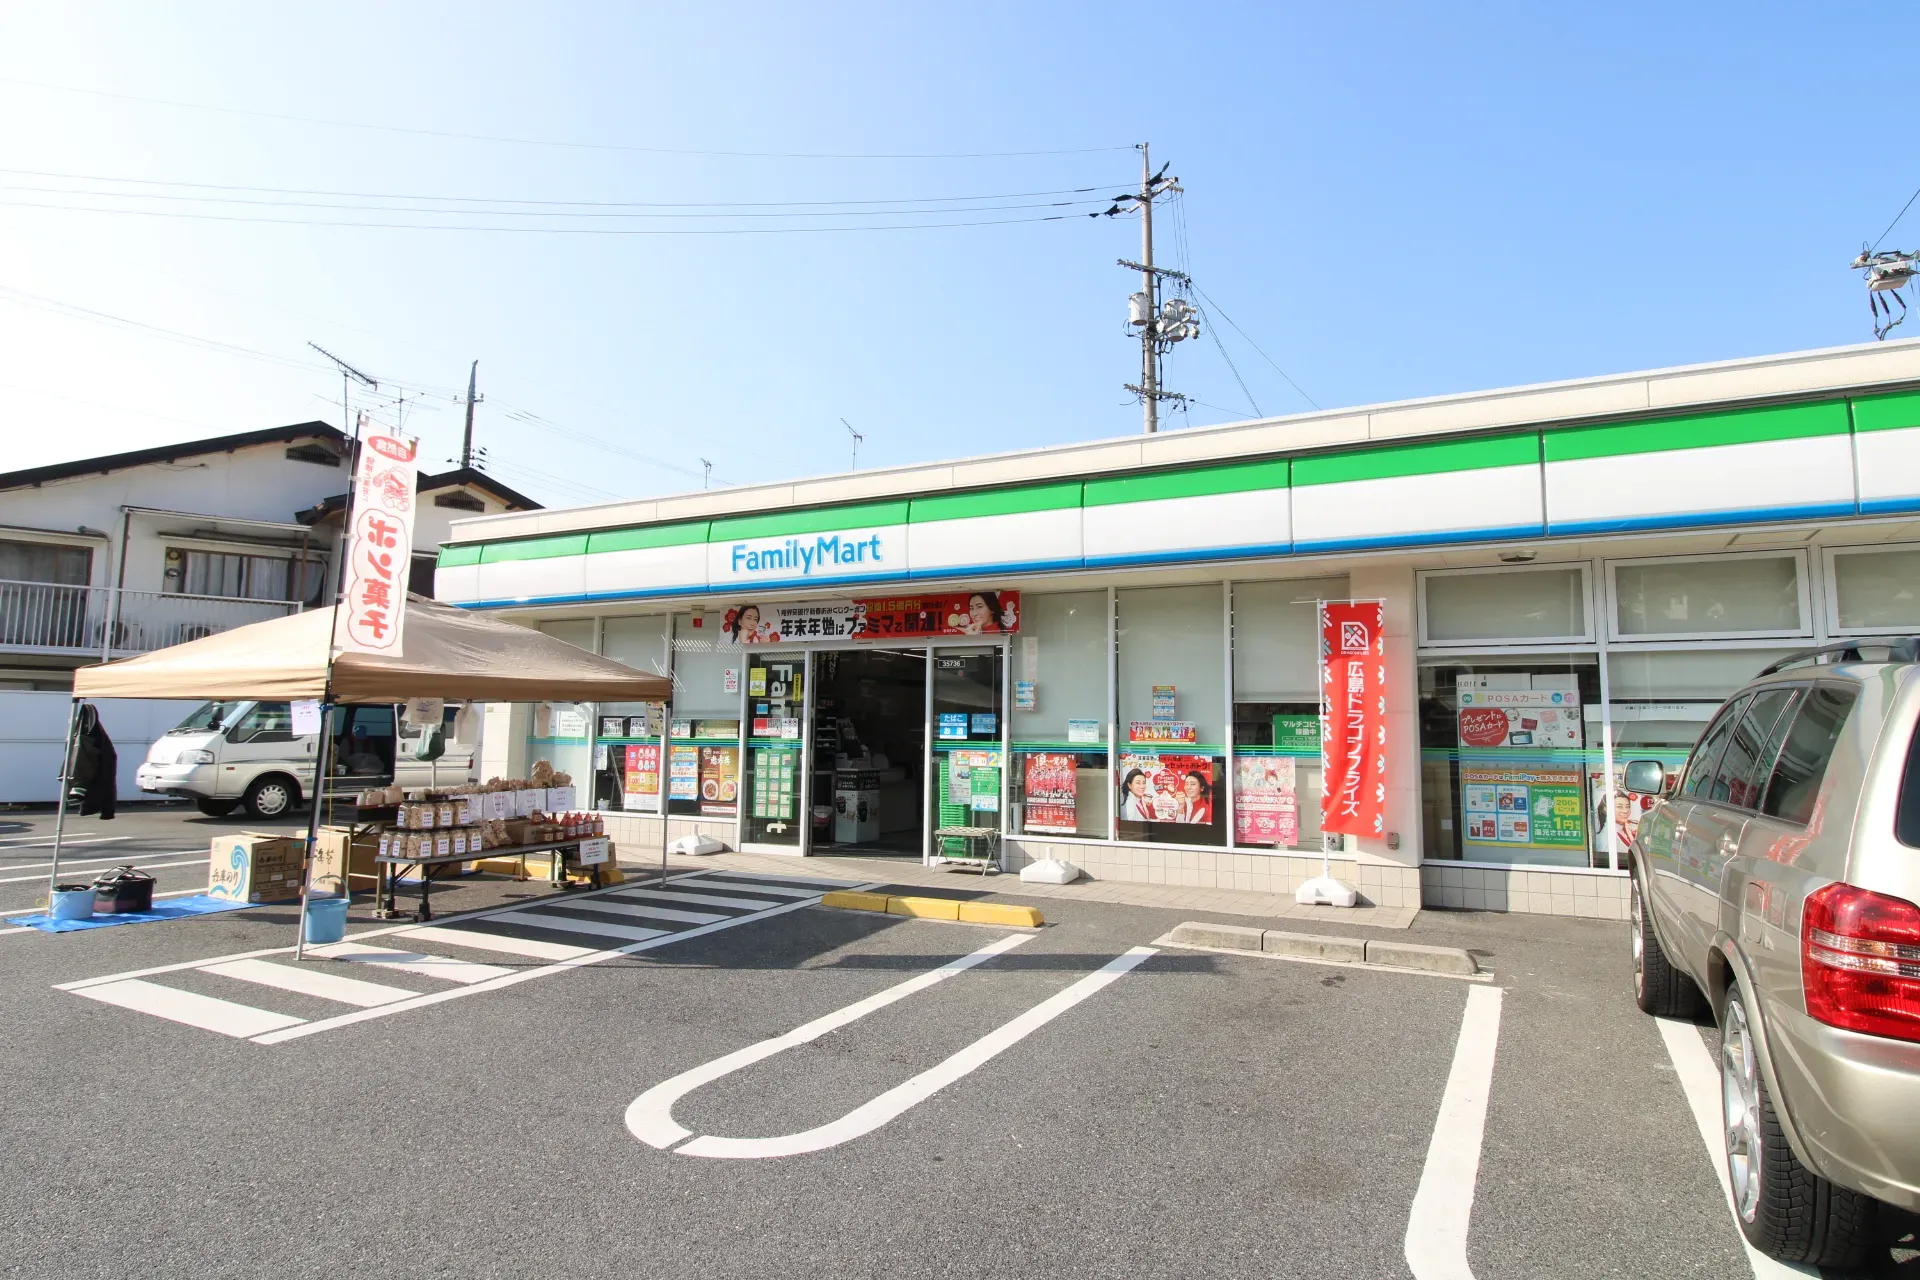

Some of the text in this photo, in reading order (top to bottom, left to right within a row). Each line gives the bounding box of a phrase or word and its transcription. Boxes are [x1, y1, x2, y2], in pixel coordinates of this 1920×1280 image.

[732, 533, 882, 574] FamilyMart
[1487, 694, 1549, 703] POSAカード
[944, 714, 963, 722] たばこ
[1461, 710, 1503, 724] プレゼントに
[1463, 720, 1505, 734] POSAカード
[1341, 661, 1364, 817] 広島ドラゴンフライズ
